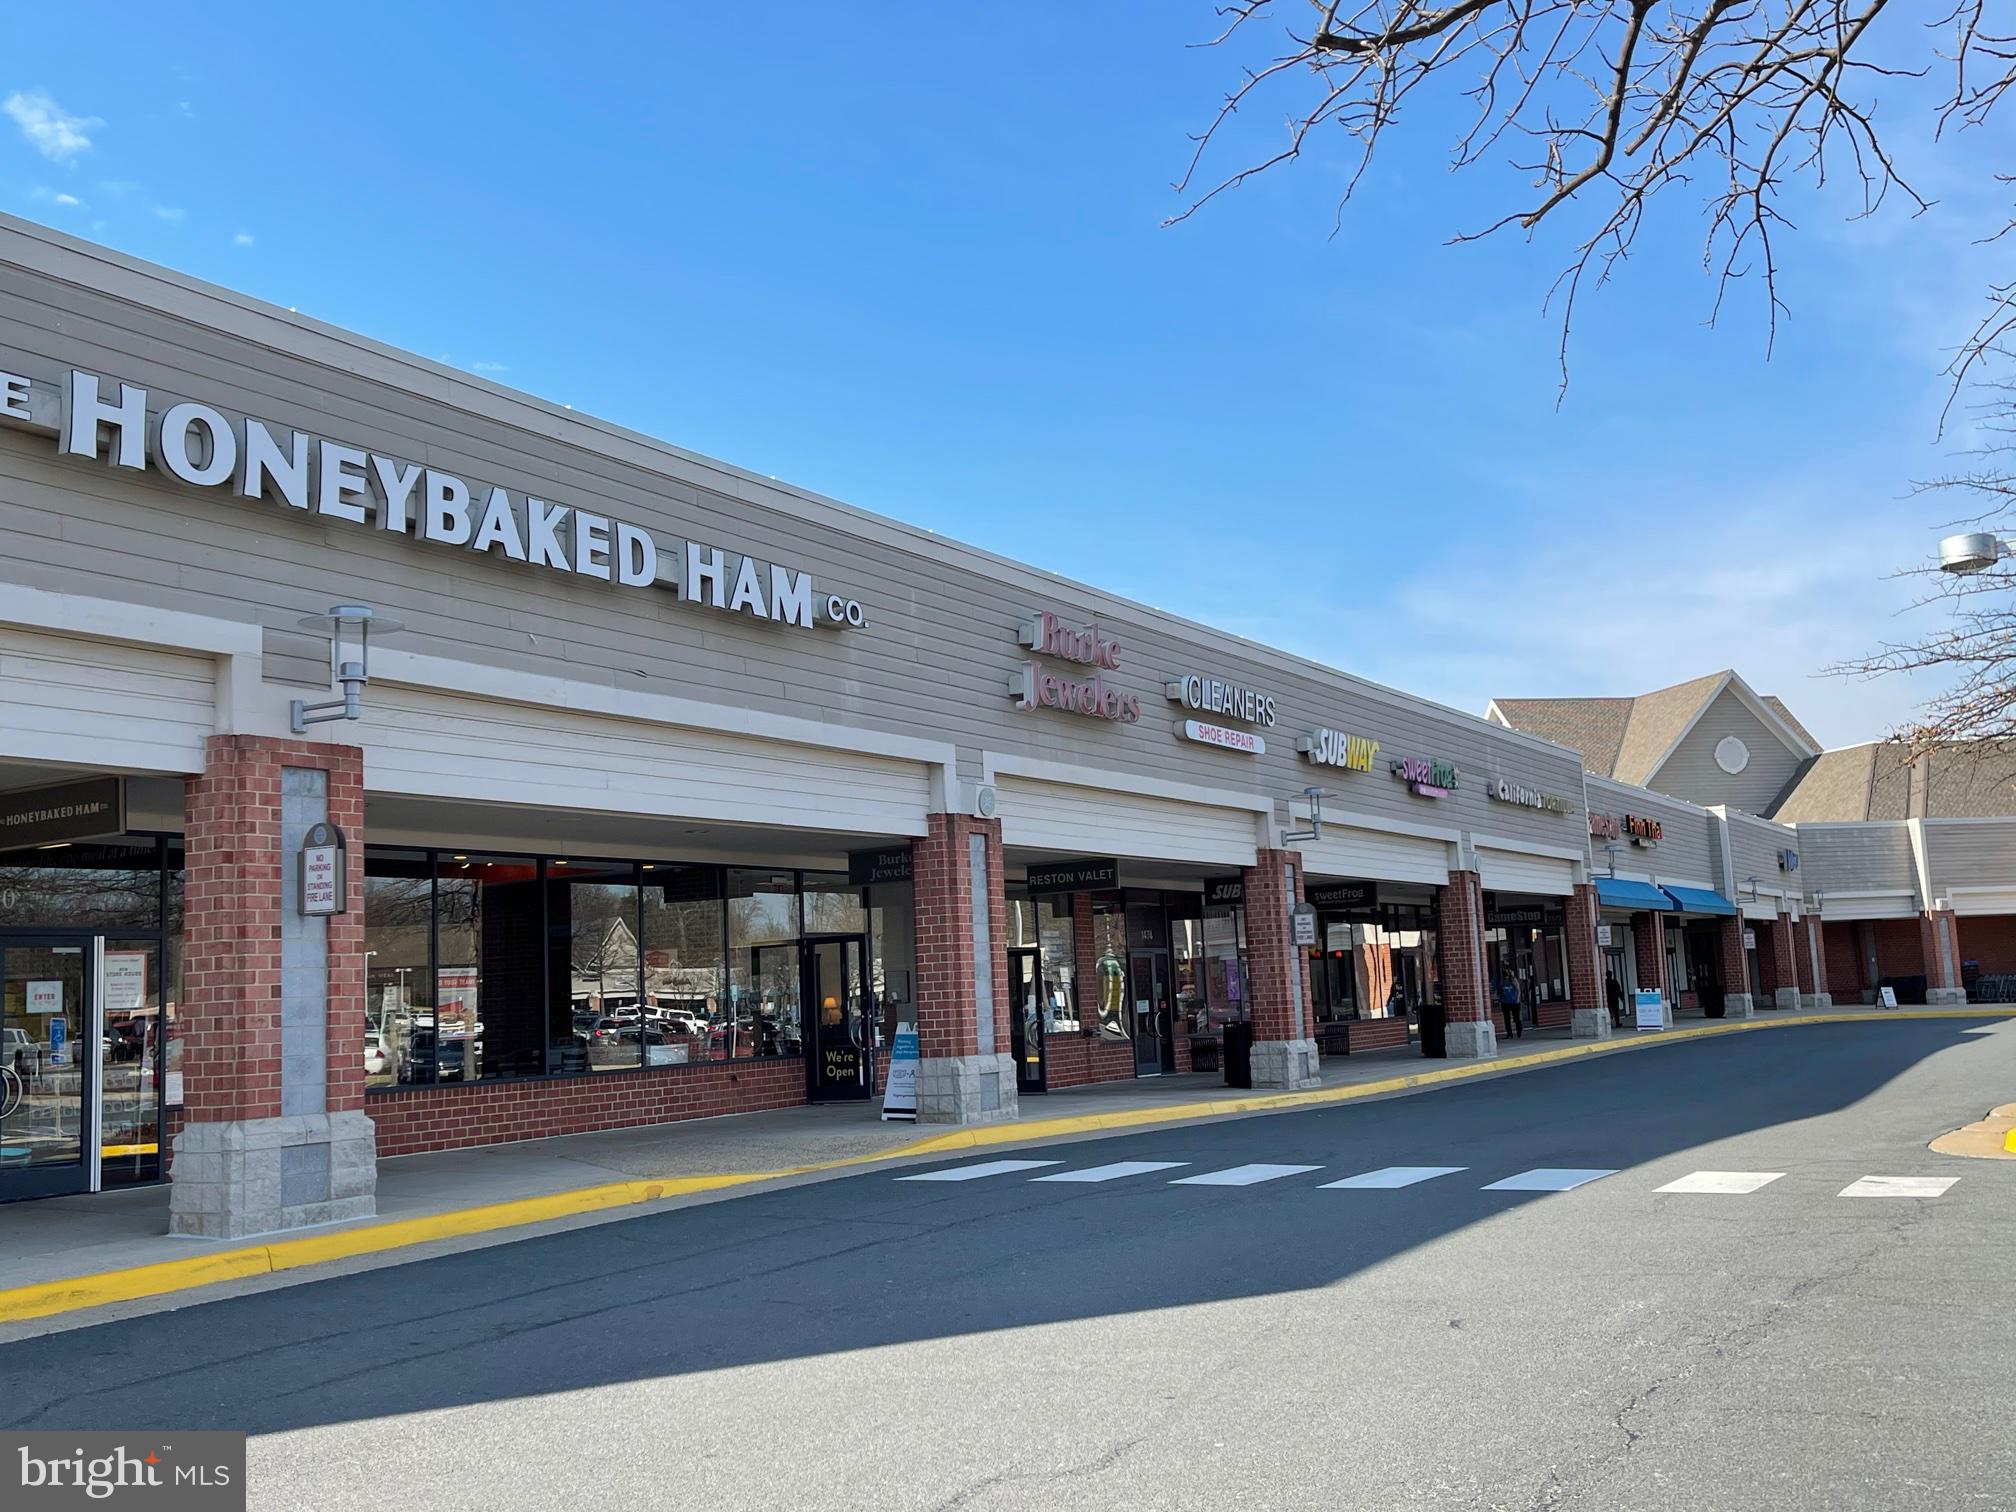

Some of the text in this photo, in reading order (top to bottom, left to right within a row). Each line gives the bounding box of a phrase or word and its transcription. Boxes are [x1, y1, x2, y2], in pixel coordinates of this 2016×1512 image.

[66, 369, 658, 588] HONEYBAKED
[685, 540, 814, 630] HAM
[826, 595, 870, 629] CO.
[1031, 611, 1121, 671] Burke
[1016, 659, 1141, 723] Jewelers
[1187, 674, 1276, 728] CLEANERS
[1198, 724, 1255, 750] SHOE REPAIR
[1316, 728, 1380, 773] SUBWAY
[6, 806, 73, 827] HONEYBAKED
[75, 802, 100, 816] HAM
[315, 854, 324, 862] NO
[308, 863, 331, 872] PARKING
[1029, 868, 1114, 886] RESTON VALET
[307, 881, 333, 891] STANDING
[1212, 883, 1242, 900] SUB
[319, 891, 333, 902] LANE
[34, 992, 55, 1001] ENTER
[826, 1049, 854, 1063] We're
[826, 1065, 855, 1081] Open
